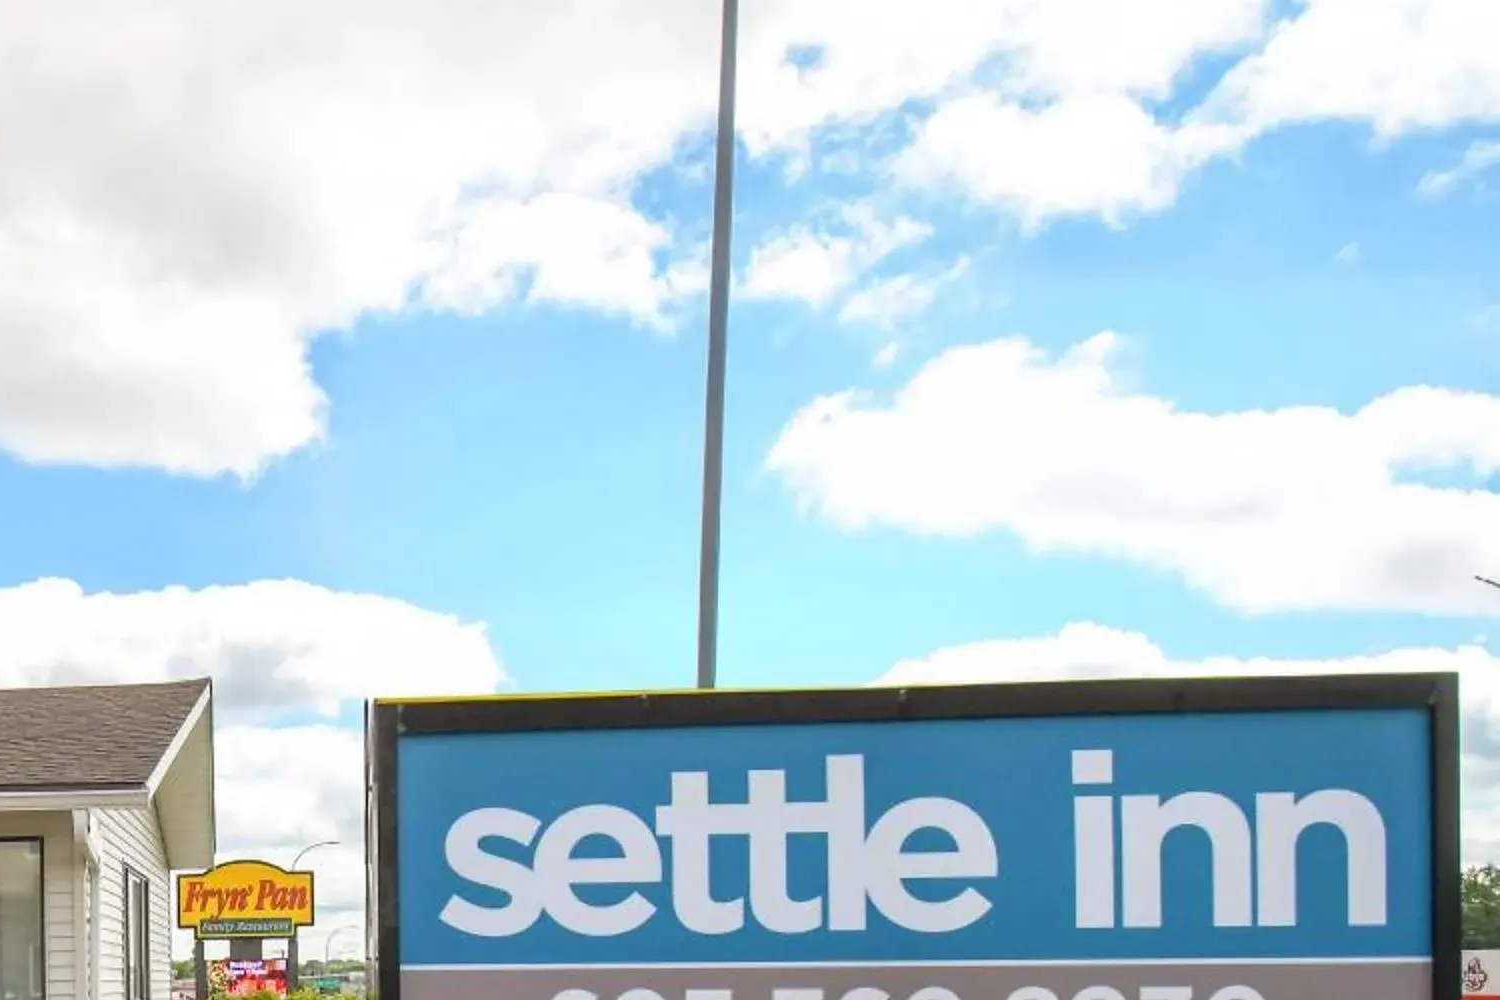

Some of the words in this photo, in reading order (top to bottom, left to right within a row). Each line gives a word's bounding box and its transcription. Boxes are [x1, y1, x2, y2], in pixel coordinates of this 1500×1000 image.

[253, 879, 308, 911] Pan
[439, 753, 999, 937] settle
[1071, 749, 1387, 929] inn
